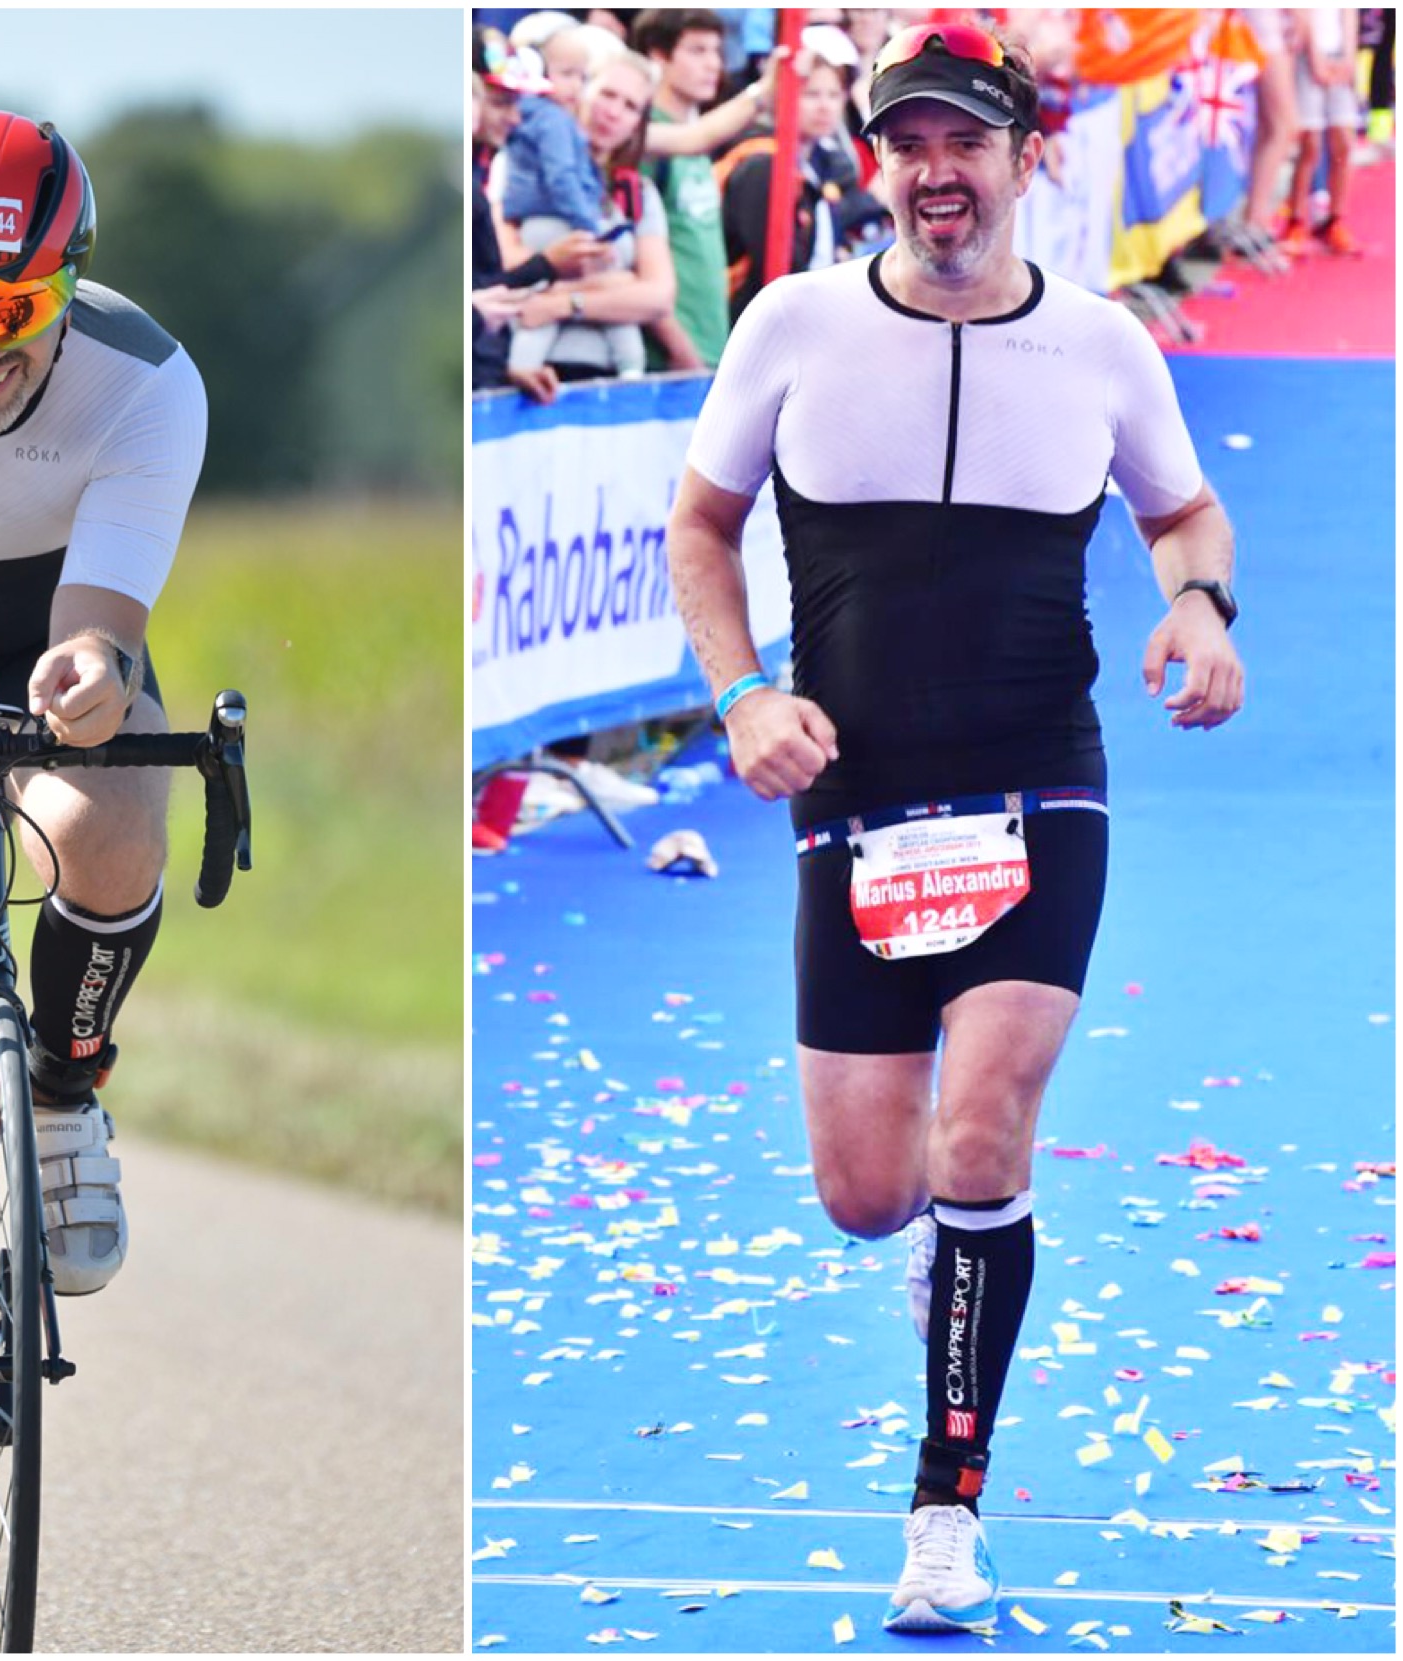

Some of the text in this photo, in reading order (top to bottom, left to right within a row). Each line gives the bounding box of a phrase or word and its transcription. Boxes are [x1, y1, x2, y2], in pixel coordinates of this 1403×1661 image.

[493, 478, 678, 658] Raboban
[855, 864, 1025, 908] Marius Alexandru
[903, 903, 978, 936] 1244
